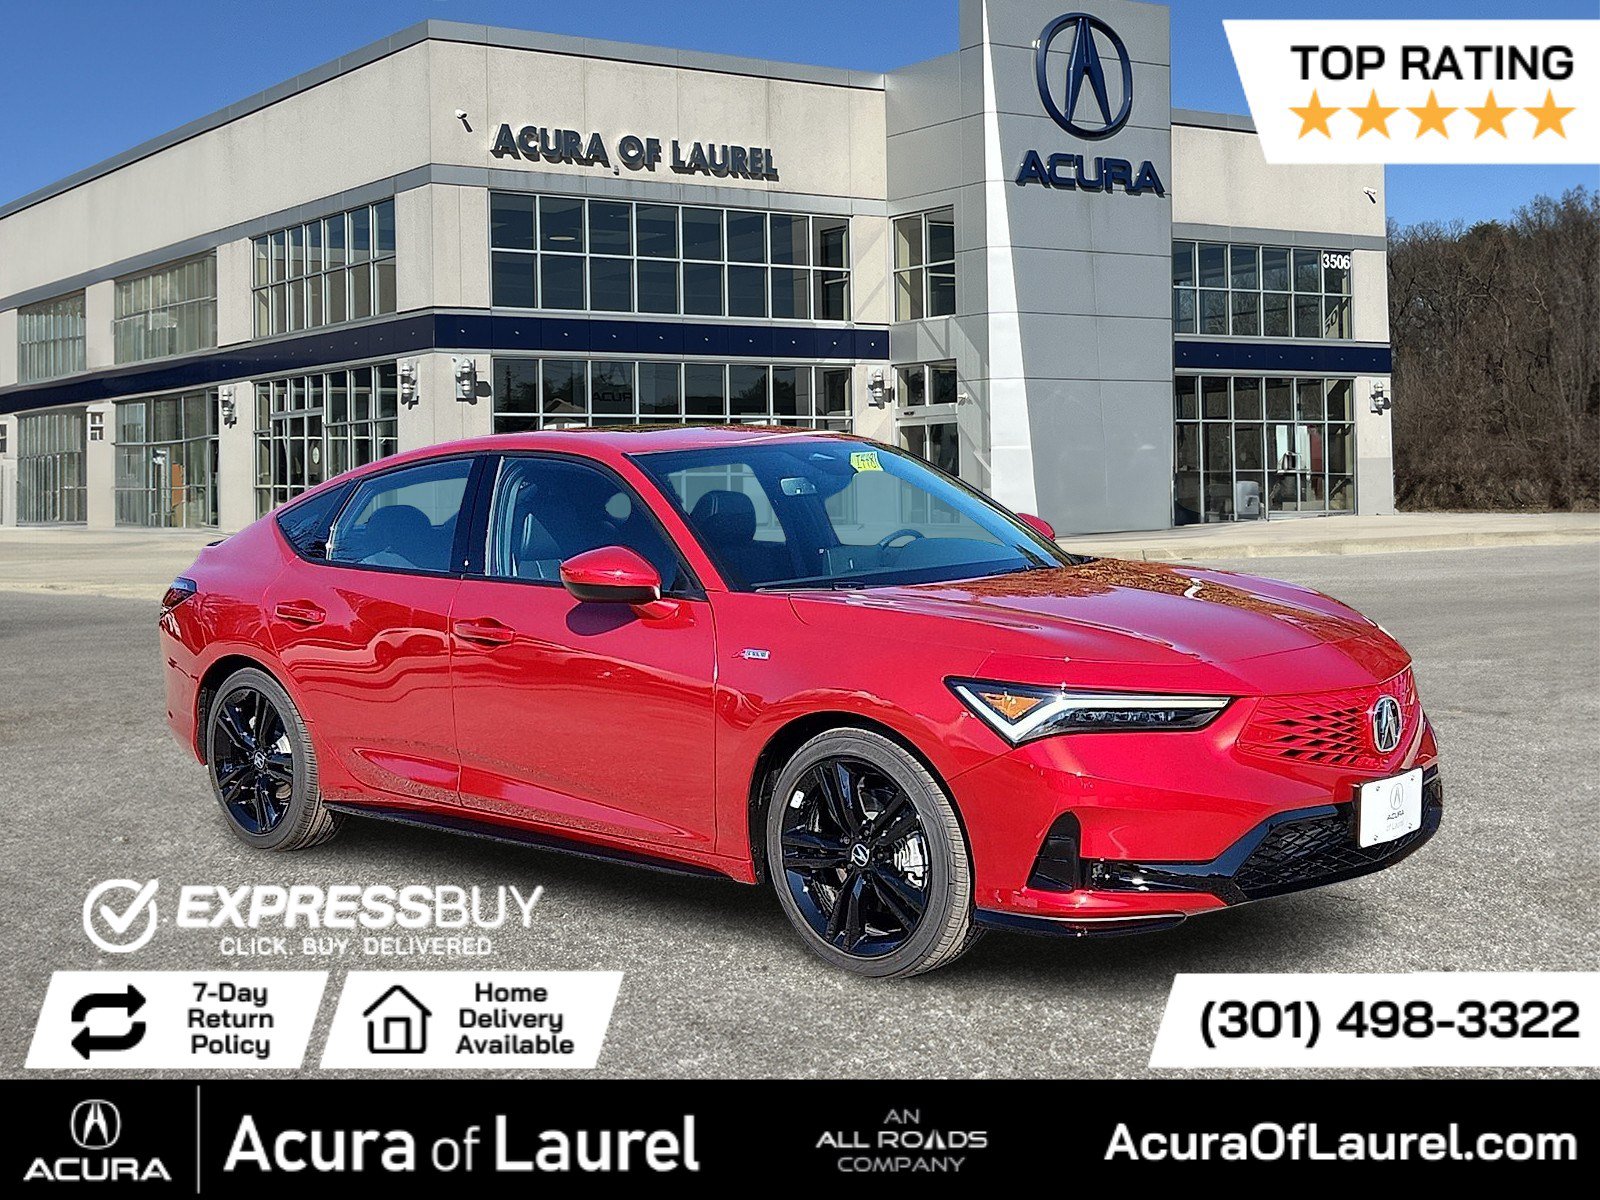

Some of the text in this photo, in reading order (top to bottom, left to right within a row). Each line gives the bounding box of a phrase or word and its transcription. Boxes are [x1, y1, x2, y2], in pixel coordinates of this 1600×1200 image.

[490, 124, 779, 182] ACURA OF LAUREL
[1015, 149, 1166, 198] ACURA
[1322, 253, 1351, 270] 3506
